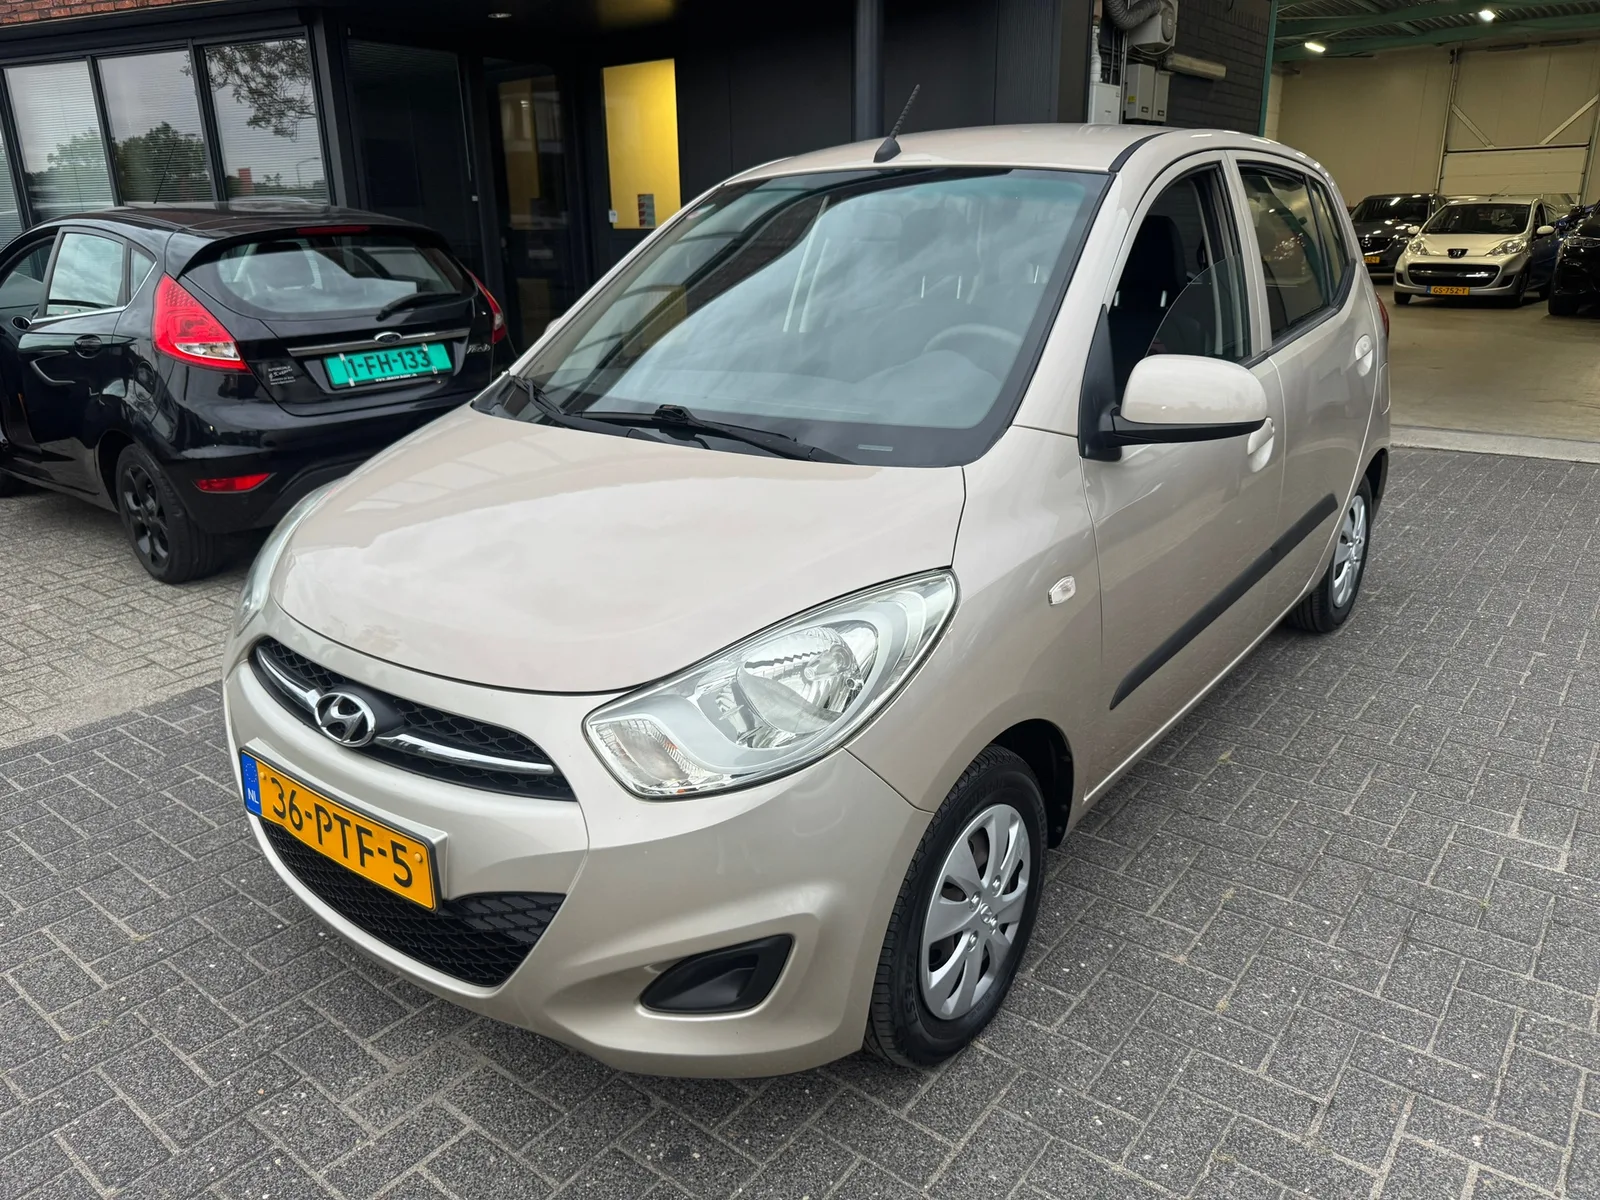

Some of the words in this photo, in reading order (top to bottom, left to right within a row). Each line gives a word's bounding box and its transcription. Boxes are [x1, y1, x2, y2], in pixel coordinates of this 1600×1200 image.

[1433, 286, 1466, 295] GS-752-T
[348, 350, 432, 377] 1-FH-133
[247, 787, 260, 805] NL
[270, 776, 413, 888] 36-PTF-5
